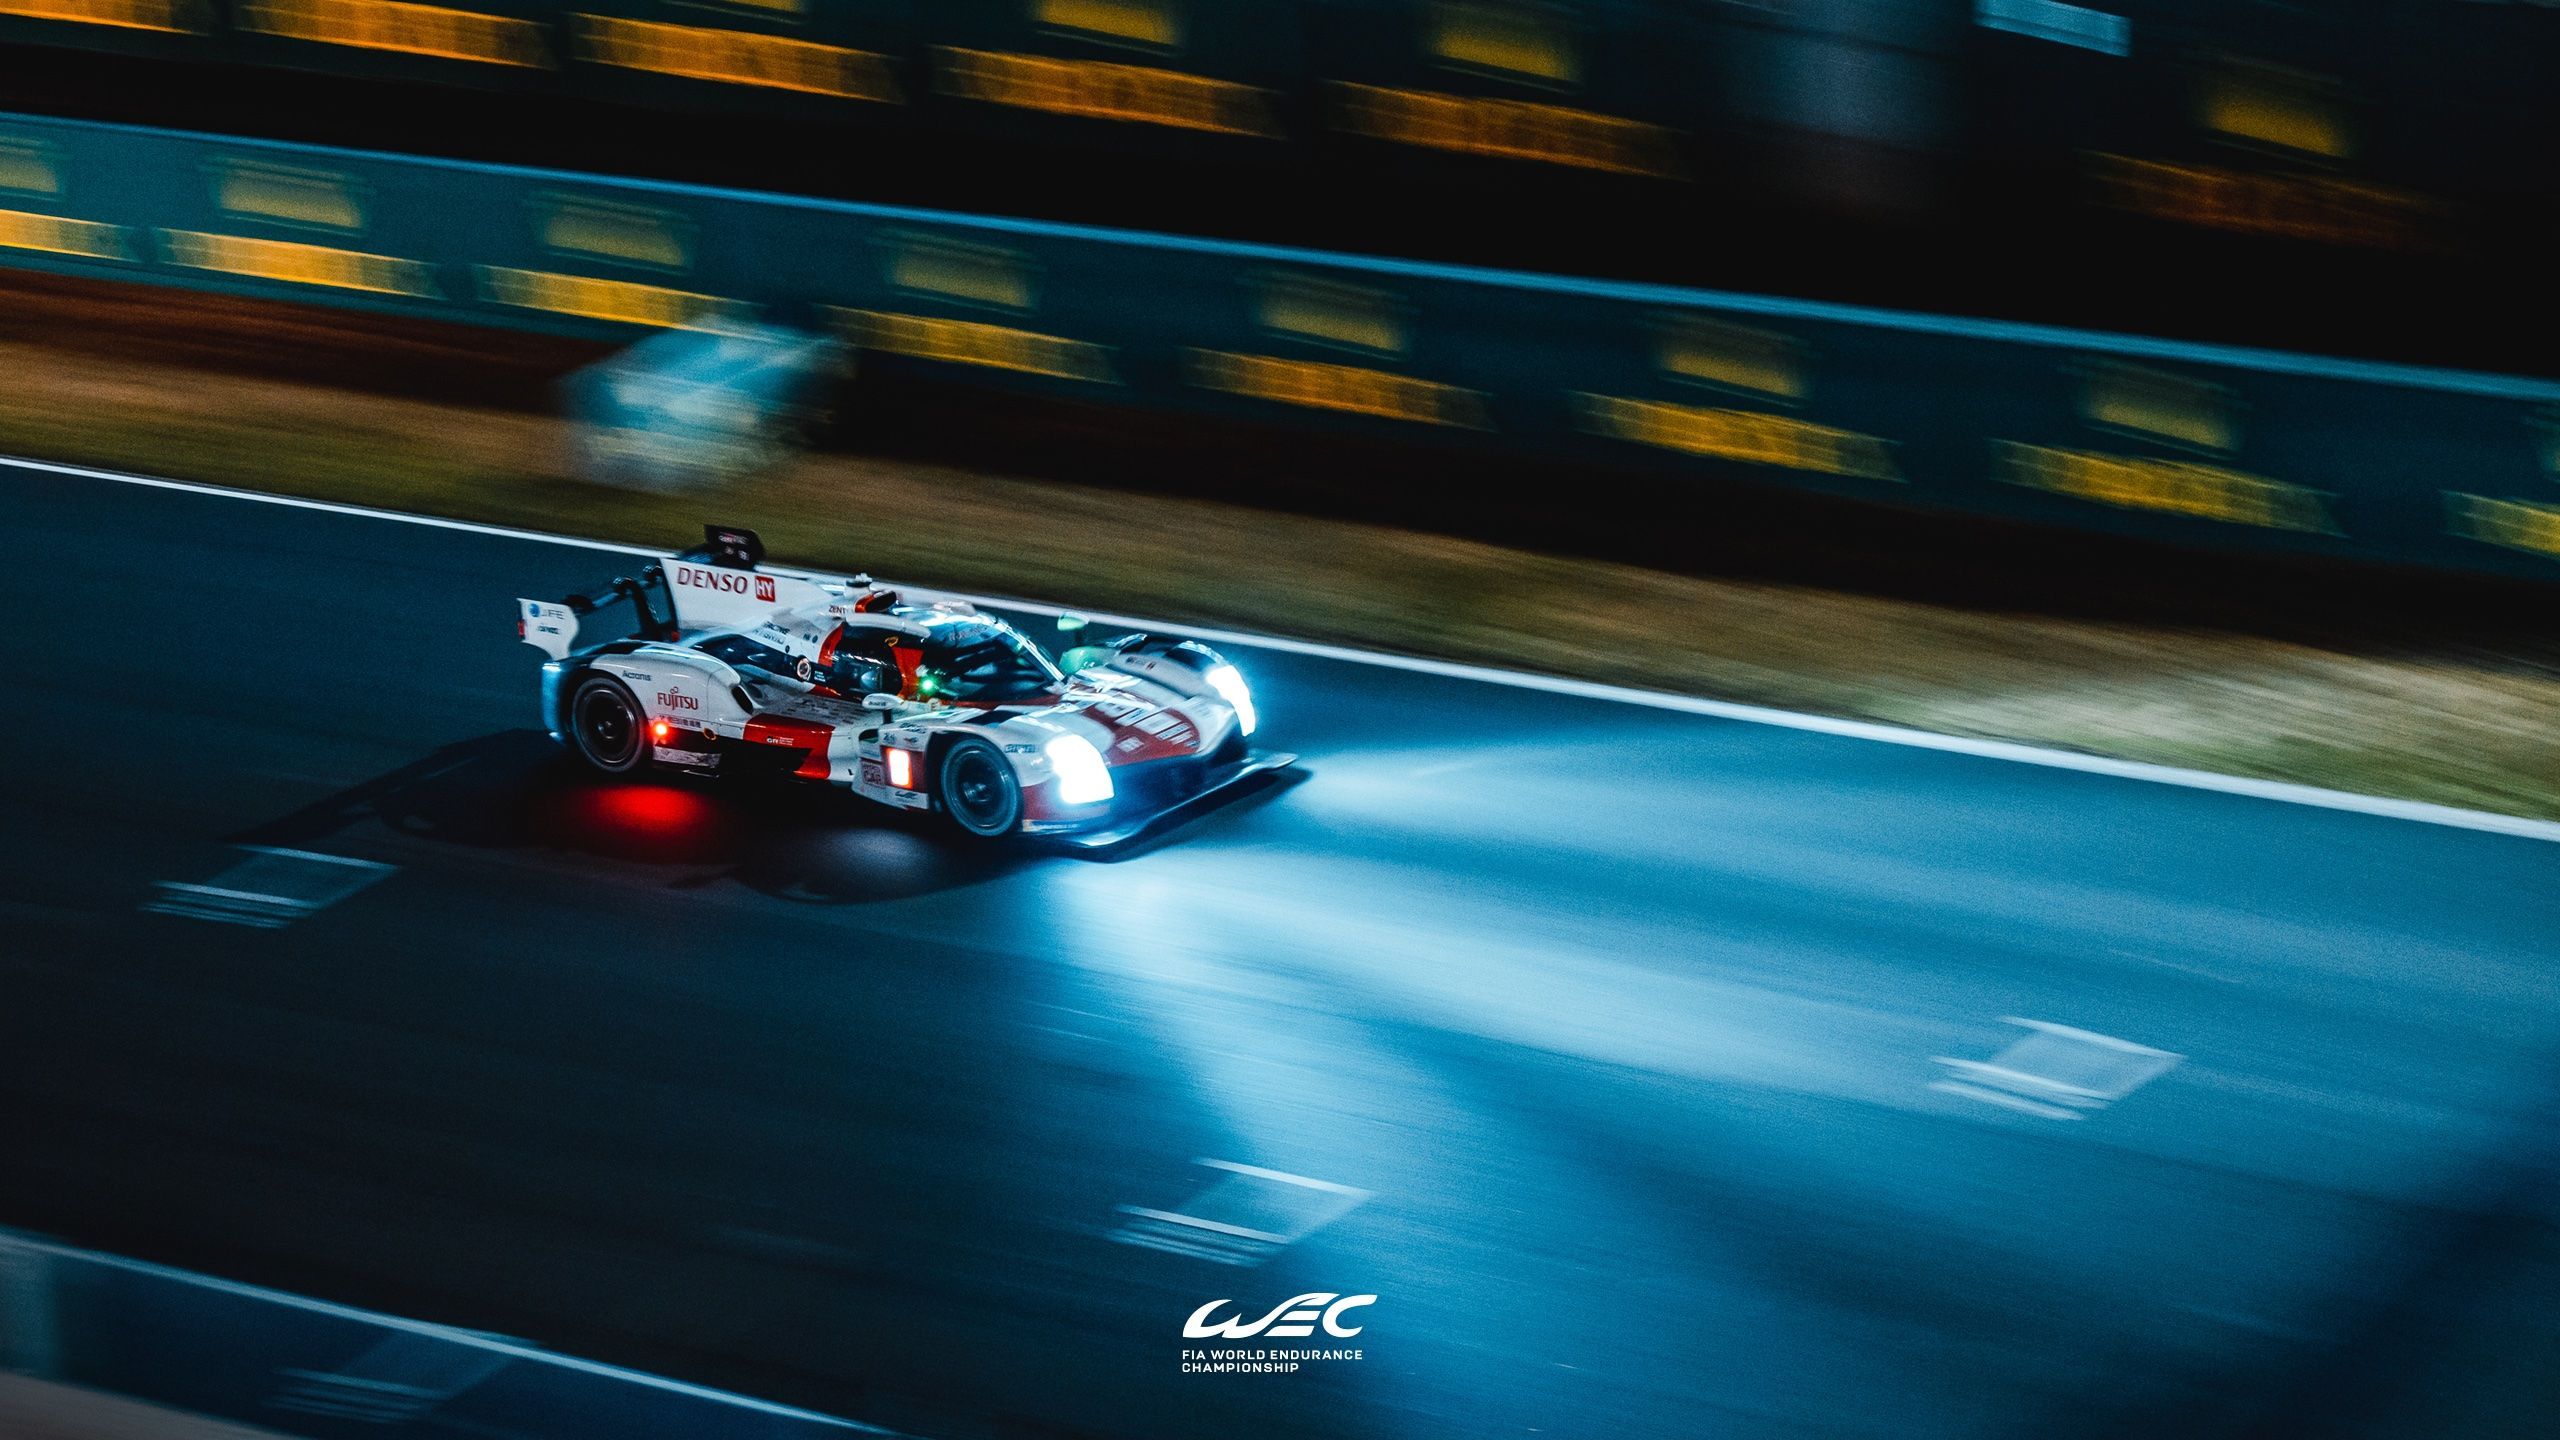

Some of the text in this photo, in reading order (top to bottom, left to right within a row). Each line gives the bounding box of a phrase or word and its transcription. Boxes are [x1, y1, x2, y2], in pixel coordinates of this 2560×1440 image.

[677, 567, 773, 599] DENSO HY
[657, 687, 699, 710] FUJITSU
